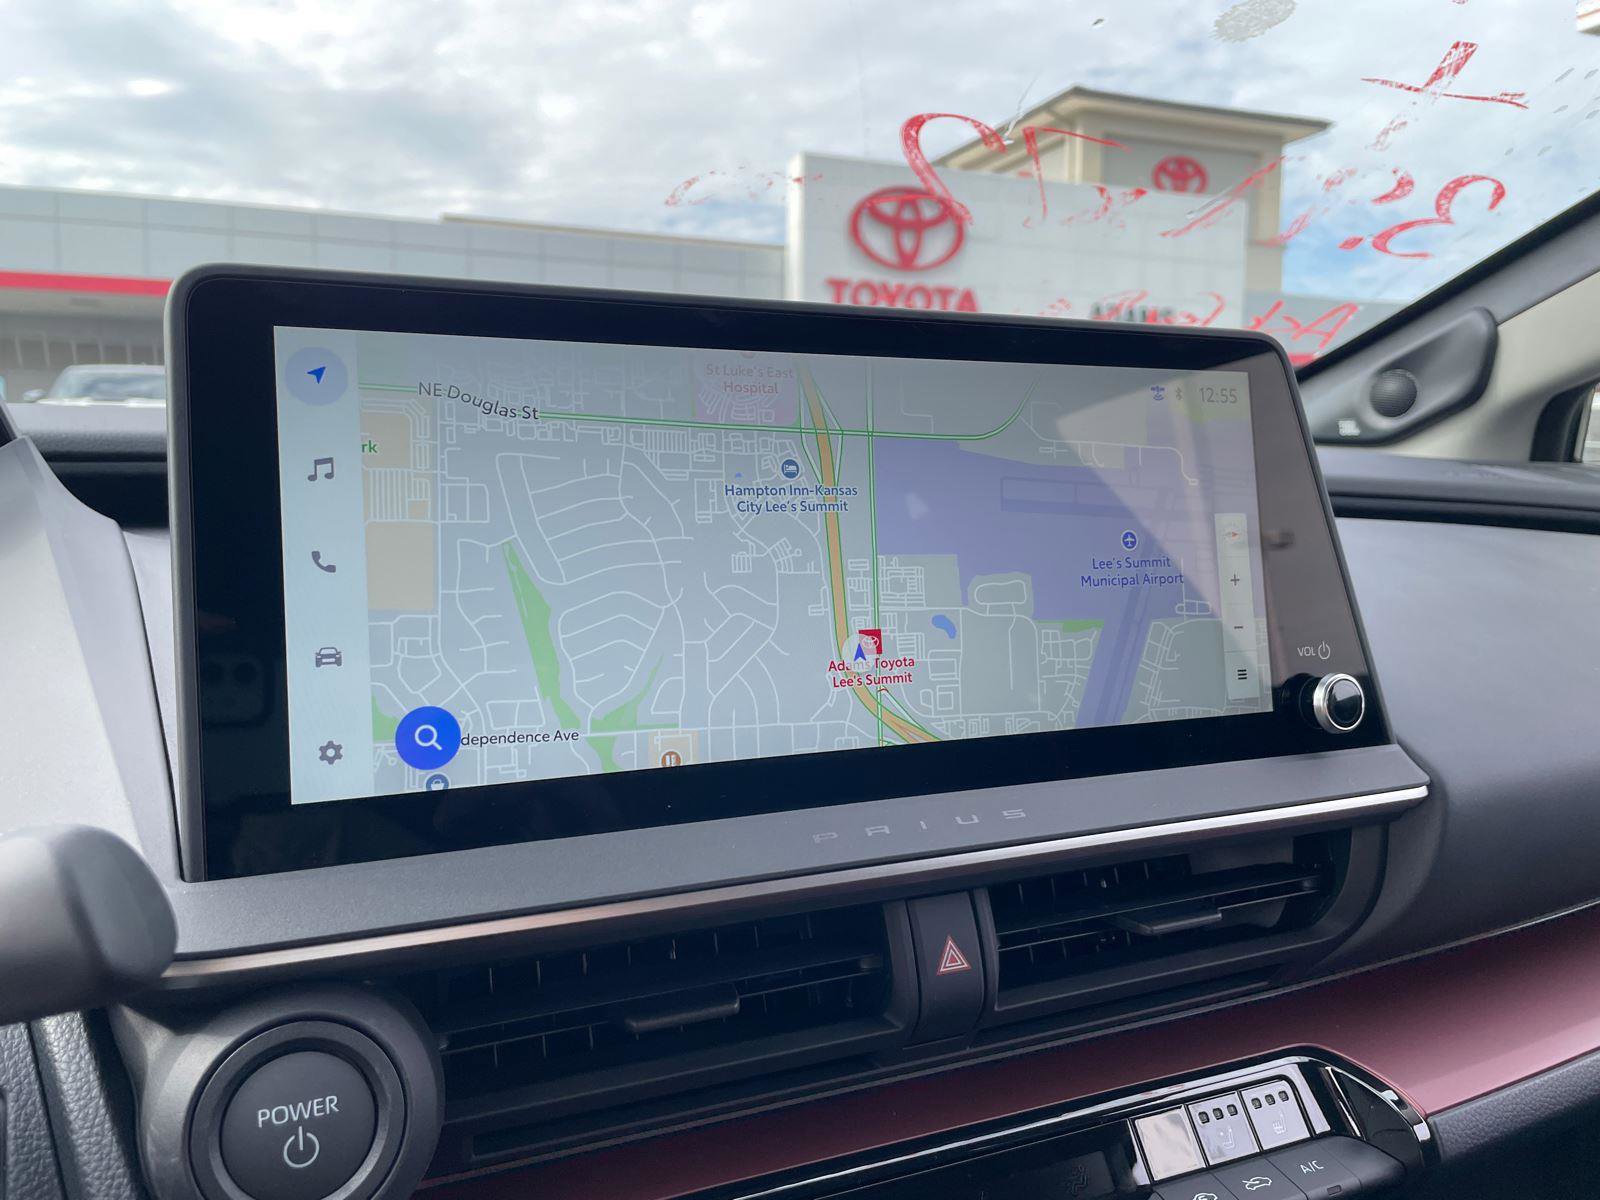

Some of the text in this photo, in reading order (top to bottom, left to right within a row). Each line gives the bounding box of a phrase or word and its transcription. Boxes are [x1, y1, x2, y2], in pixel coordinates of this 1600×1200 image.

[826, 278, 979, 312] TOYOTA
[706, 364, 794, 379] St Luke's East
[723, 381, 778, 396] Hospital
[1199, 387, 1238, 404] 12:55
[418, 382, 539, 420] NE Douglas St
[724, 484, 858, 498] Hampton Inn-Kansas
[737, 501, 849, 515] City Lee's Summit
[1092, 556, 1171, 570] Lee's Summit
[1080, 573, 1184, 589] Municipal Airport
[1297, 646, 1316, 657] VOL
[874, 656, 915, 672] Toyota
[833, 672, 913, 688] Lee's Summit
[553, 730, 579, 742] Ave
[257, 1095, 340, 1128] POWER
[1300, 1160, 1324, 1174] A/C
